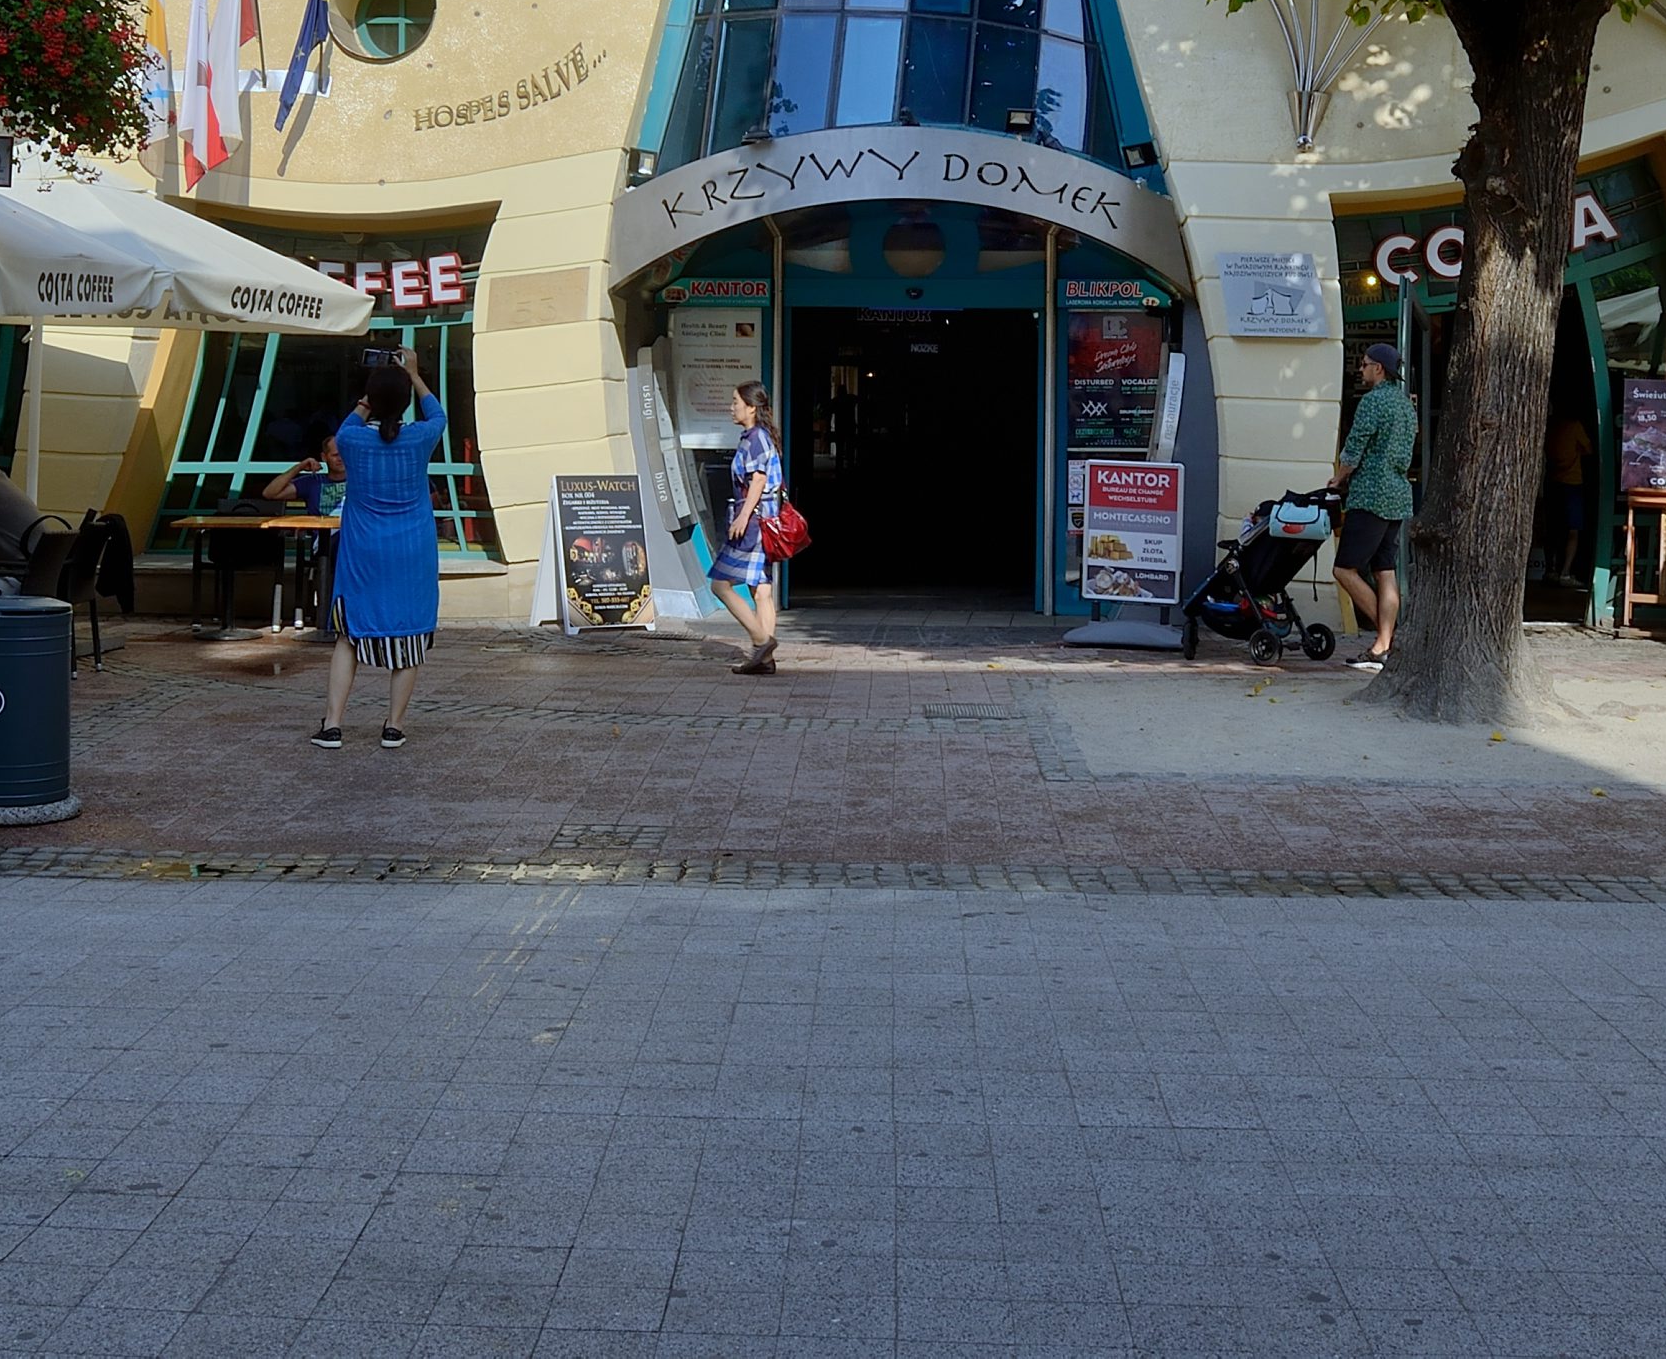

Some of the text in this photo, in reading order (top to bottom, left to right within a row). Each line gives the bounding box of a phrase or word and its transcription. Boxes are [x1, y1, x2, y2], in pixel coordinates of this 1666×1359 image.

[413, 89, 511, 131] HOSPES
[661, 148, 1121, 230] KRZYWY DOMEK
[1373, 192, 1620, 287] COA
[37, 272, 114, 306] COSTA COFFEE
[317, 252, 466, 310] FFEE
[691, 281, 768, 297] KANTOR
[1066, 281, 1143, 297] BLIKPOL
[231, 285, 273, 316] COSTA
[277, 291, 324, 320] COFFEE
[642, 385, 656, 420] usługi
[1164, 380, 1180, 441] restauracje
[654, 472, 668, 503] biura
[1097, 470, 1170, 488] KANTOR
[1137, 488, 1164, 496] CHANGE
[1108, 495, 1158, 503] WECHSELSTUBE
[1093, 512, 1171, 525] MONTECASSINO
[1140, 556, 1168, 564] SREBRA
[1135, 572, 1169, 581] LOMBARD
